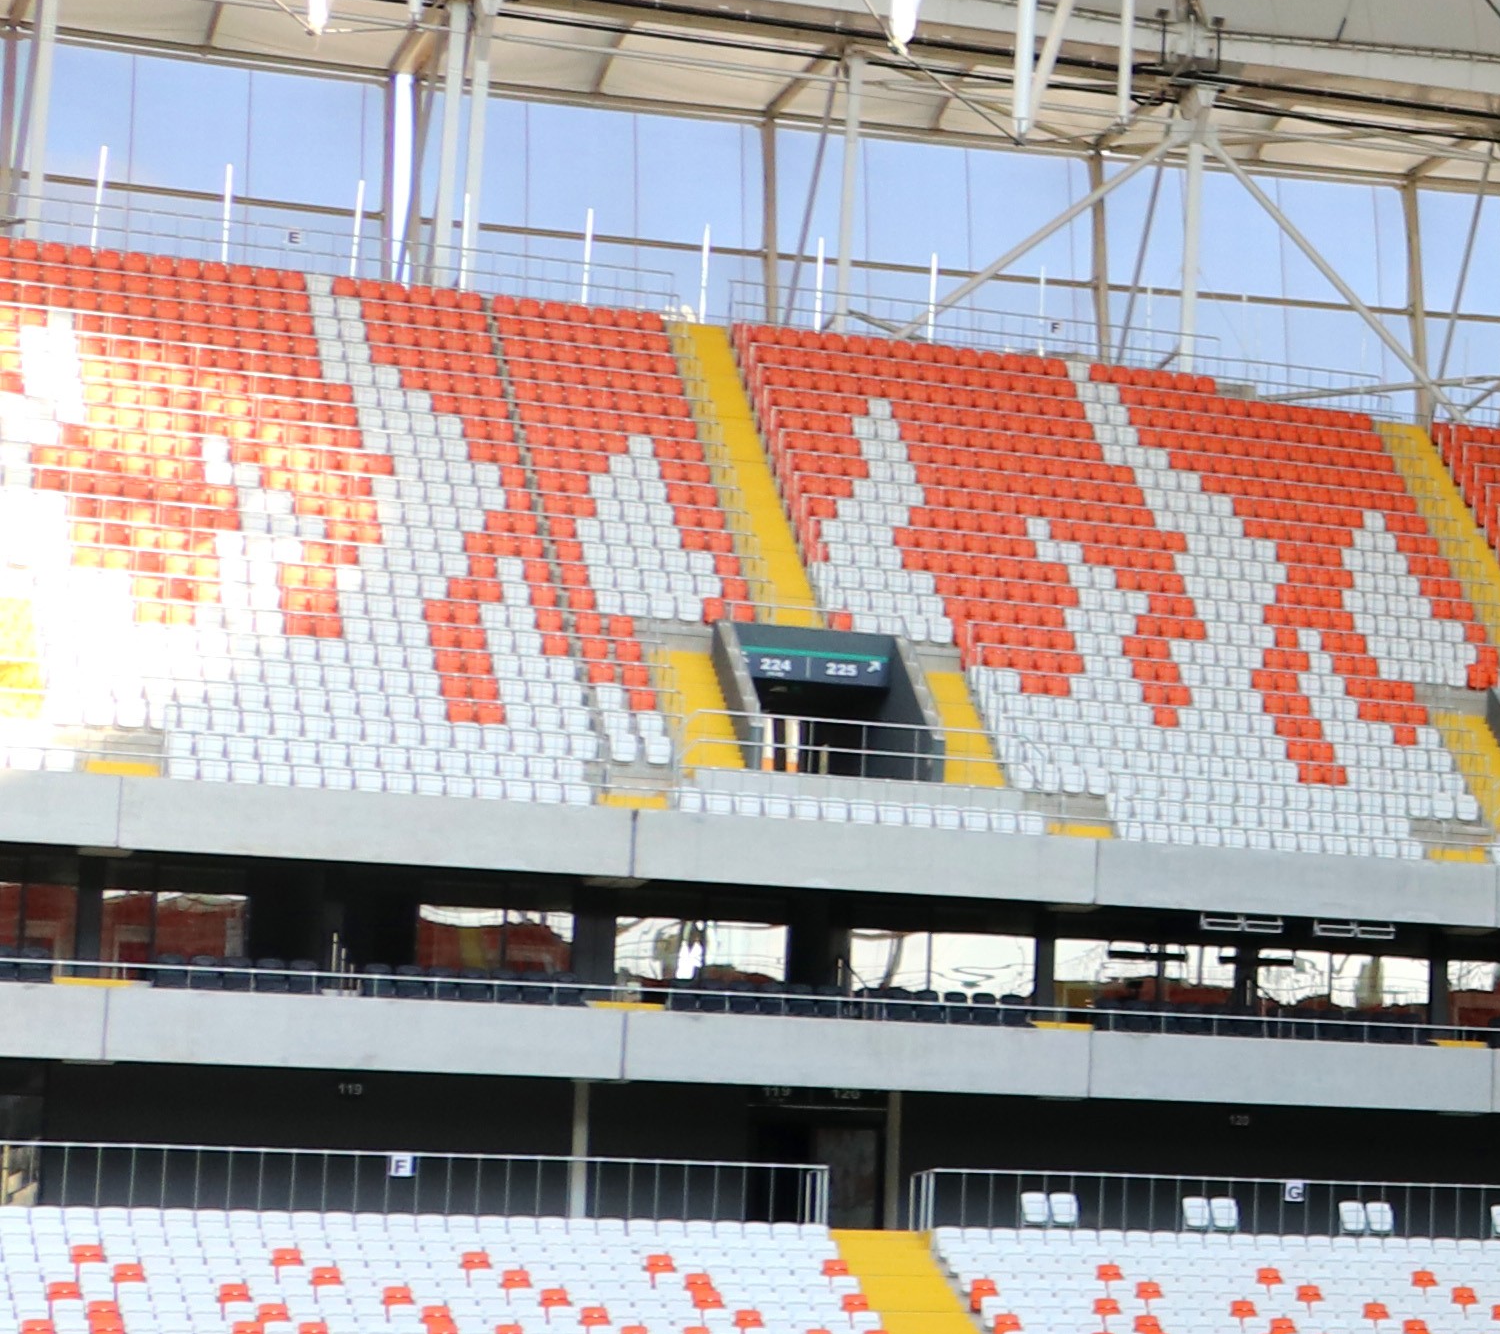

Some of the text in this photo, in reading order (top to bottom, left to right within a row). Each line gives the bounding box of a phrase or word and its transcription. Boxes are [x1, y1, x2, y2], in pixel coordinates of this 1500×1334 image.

[288, 231, 301, 244] E
[1050, 322, 1060, 333] F
[760, 658, 858, 676] 224 225
[338, 1082, 363, 1095] 119
[395, 1159, 408, 1175] F
[1288, 1185, 1304, 1199] G
